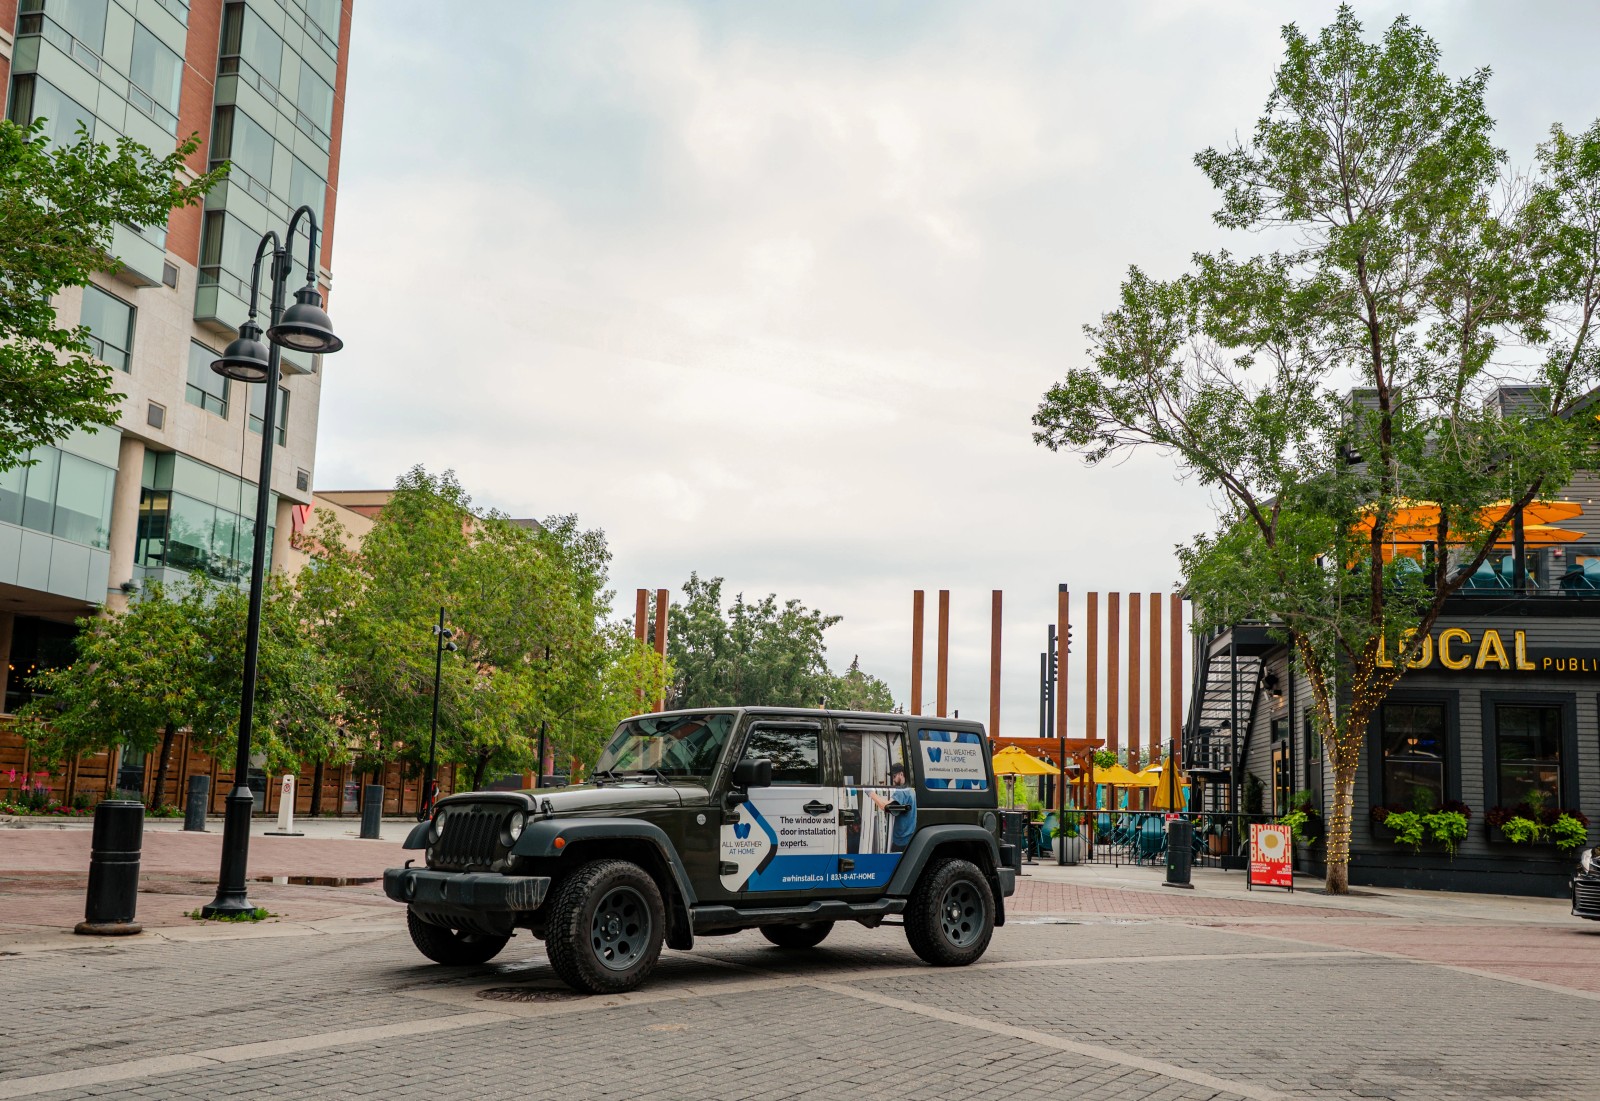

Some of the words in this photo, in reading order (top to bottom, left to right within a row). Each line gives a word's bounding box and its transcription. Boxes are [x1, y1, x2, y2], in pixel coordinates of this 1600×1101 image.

[1375, 627, 1537, 671] LOCAL
[943, 748, 953, 756] ALL
[953, 748, 977, 757] WEATHER
[951, 756, 967, 764] HOME
[780, 816, 794, 824] The
[795, 816, 822, 824] window
[822, 816, 836, 824] and
[780, 827, 797, 836] door
[798, 827, 837, 836] installation
[734, 840, 763, 848] WEATHER
[780, 839, 809, 849] experts.
[782, 874, 824, 883] awhinstall.ca
[830, 872, 876, 881] 833-8-AT-HOME
